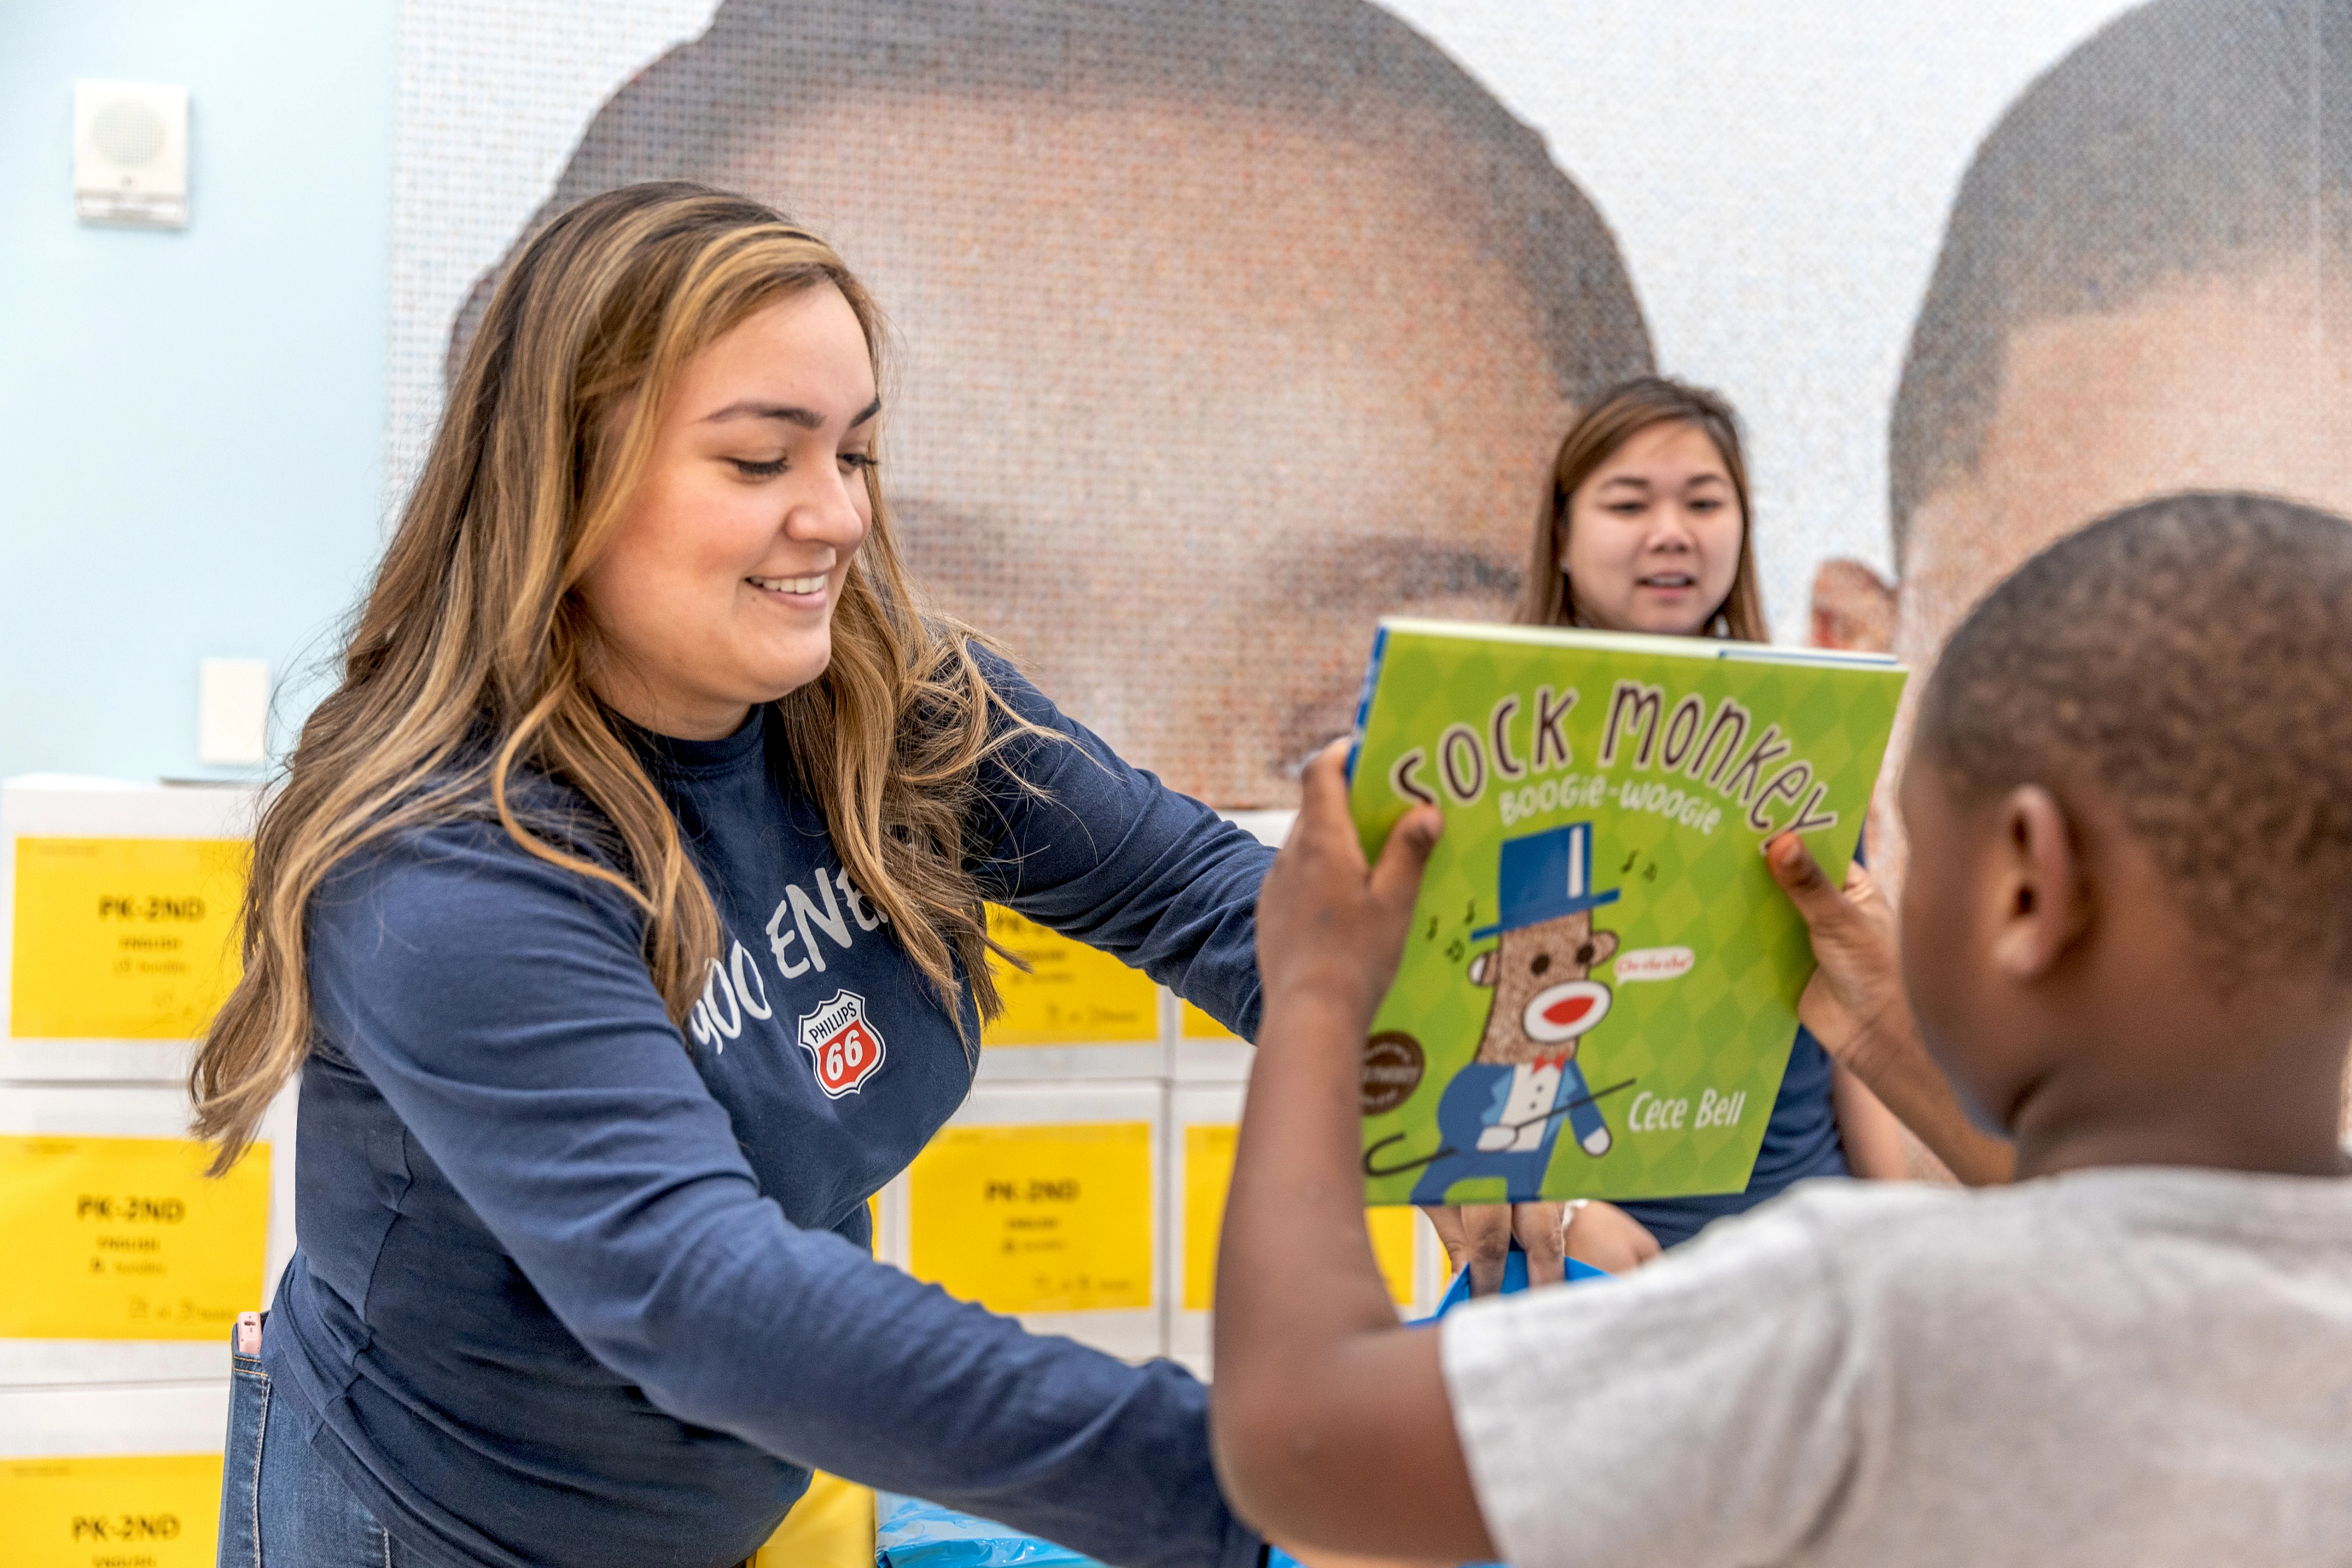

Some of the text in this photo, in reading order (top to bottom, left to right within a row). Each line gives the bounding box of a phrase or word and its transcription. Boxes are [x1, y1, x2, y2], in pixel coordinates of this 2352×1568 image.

[1391, 684, 1579, 805] SOCK
[808, 1001, 857, 1043] PHILLIPS
[826, 1029, 863, 1081] 66
[1629, 1088, 1746, 1132] Cece Bell
